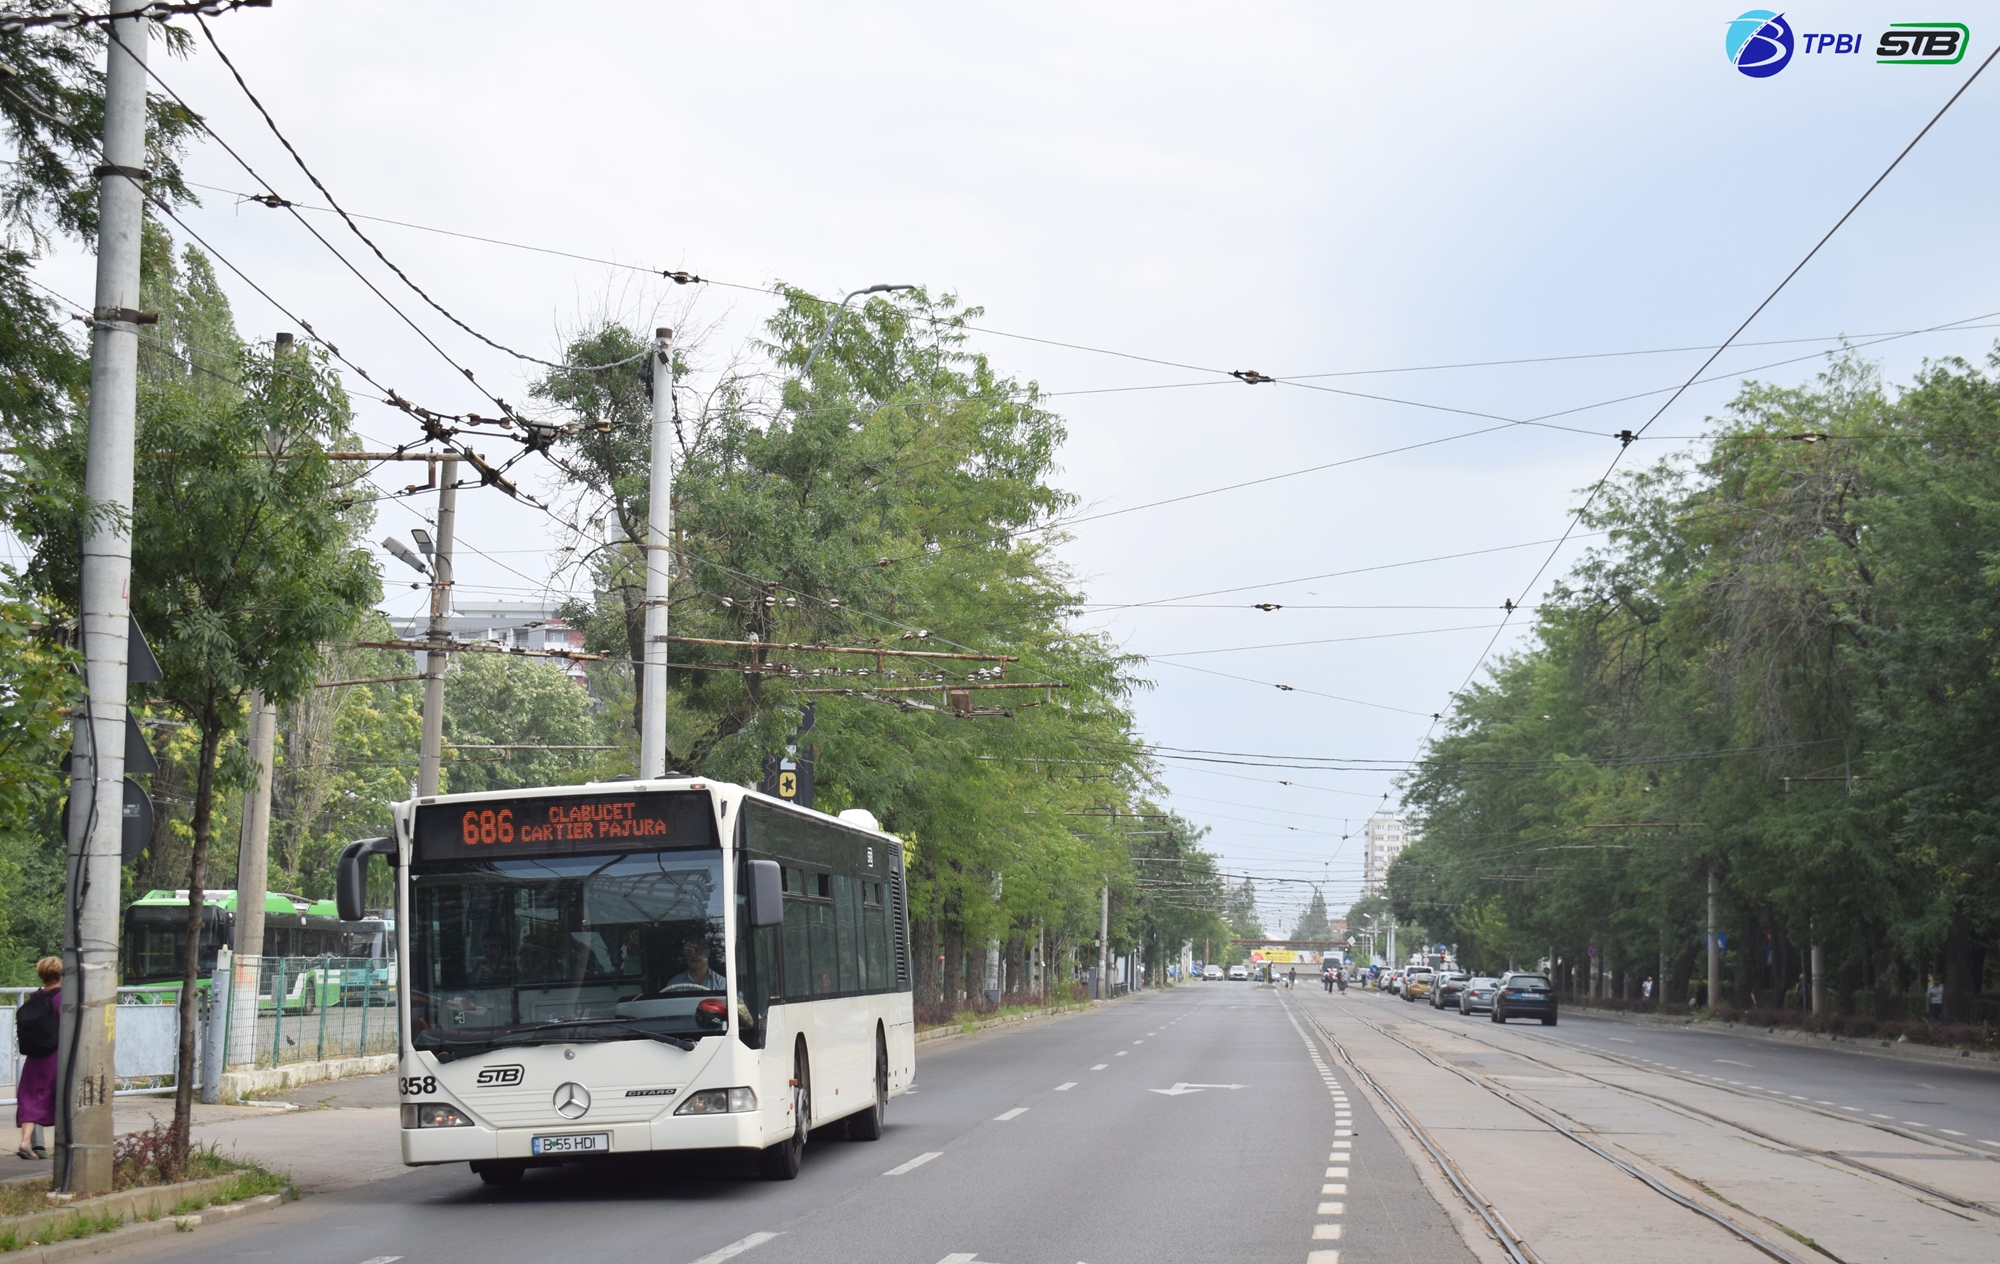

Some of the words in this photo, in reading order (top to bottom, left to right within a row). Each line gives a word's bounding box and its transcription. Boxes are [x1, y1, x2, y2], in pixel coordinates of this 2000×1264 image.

[549, 802, 636, 823] CLABUCET
[462, 808, 514, 845] 686
[521, 822, 594, 842] CARTIER
[600, 818, 667, 838] PAJURA
[399, 1075, 438, 1096] 358
[476, 1067, 521, 1085] STB
[627, 1088, 676, 1097] CITARO
[543, 1138, 553, 1151] B
[555, 1137, 572, 1151] 55
[574, 1136, 596, 1150] HDI
